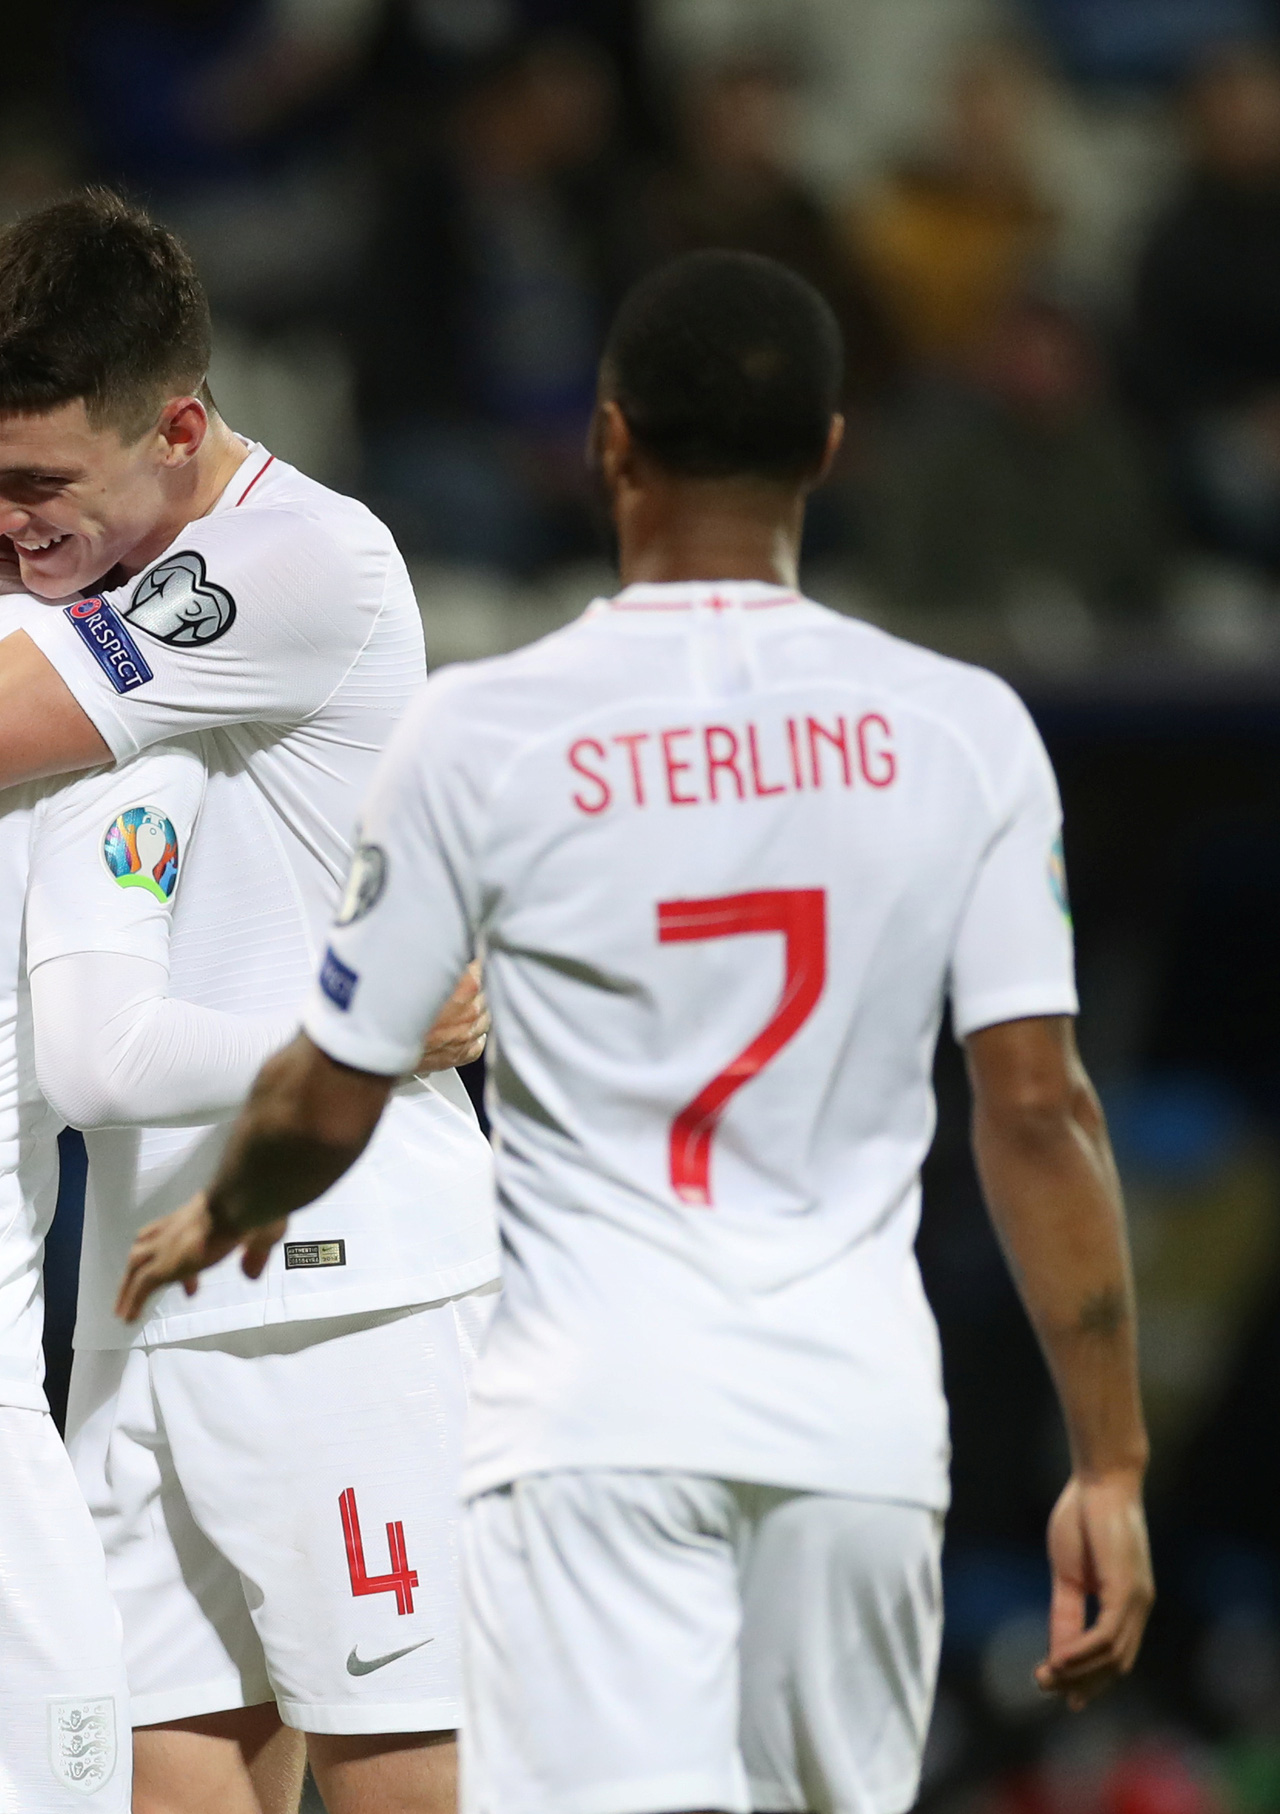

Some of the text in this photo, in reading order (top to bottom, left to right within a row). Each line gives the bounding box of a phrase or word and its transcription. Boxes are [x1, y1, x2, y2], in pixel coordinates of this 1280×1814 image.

[84, 612, 143, 686] RESPECT
[568, 713, 898, 816] STERLING
[656, 886, 828, 1206] 7
[338, 1487, 419, 1616] 4
